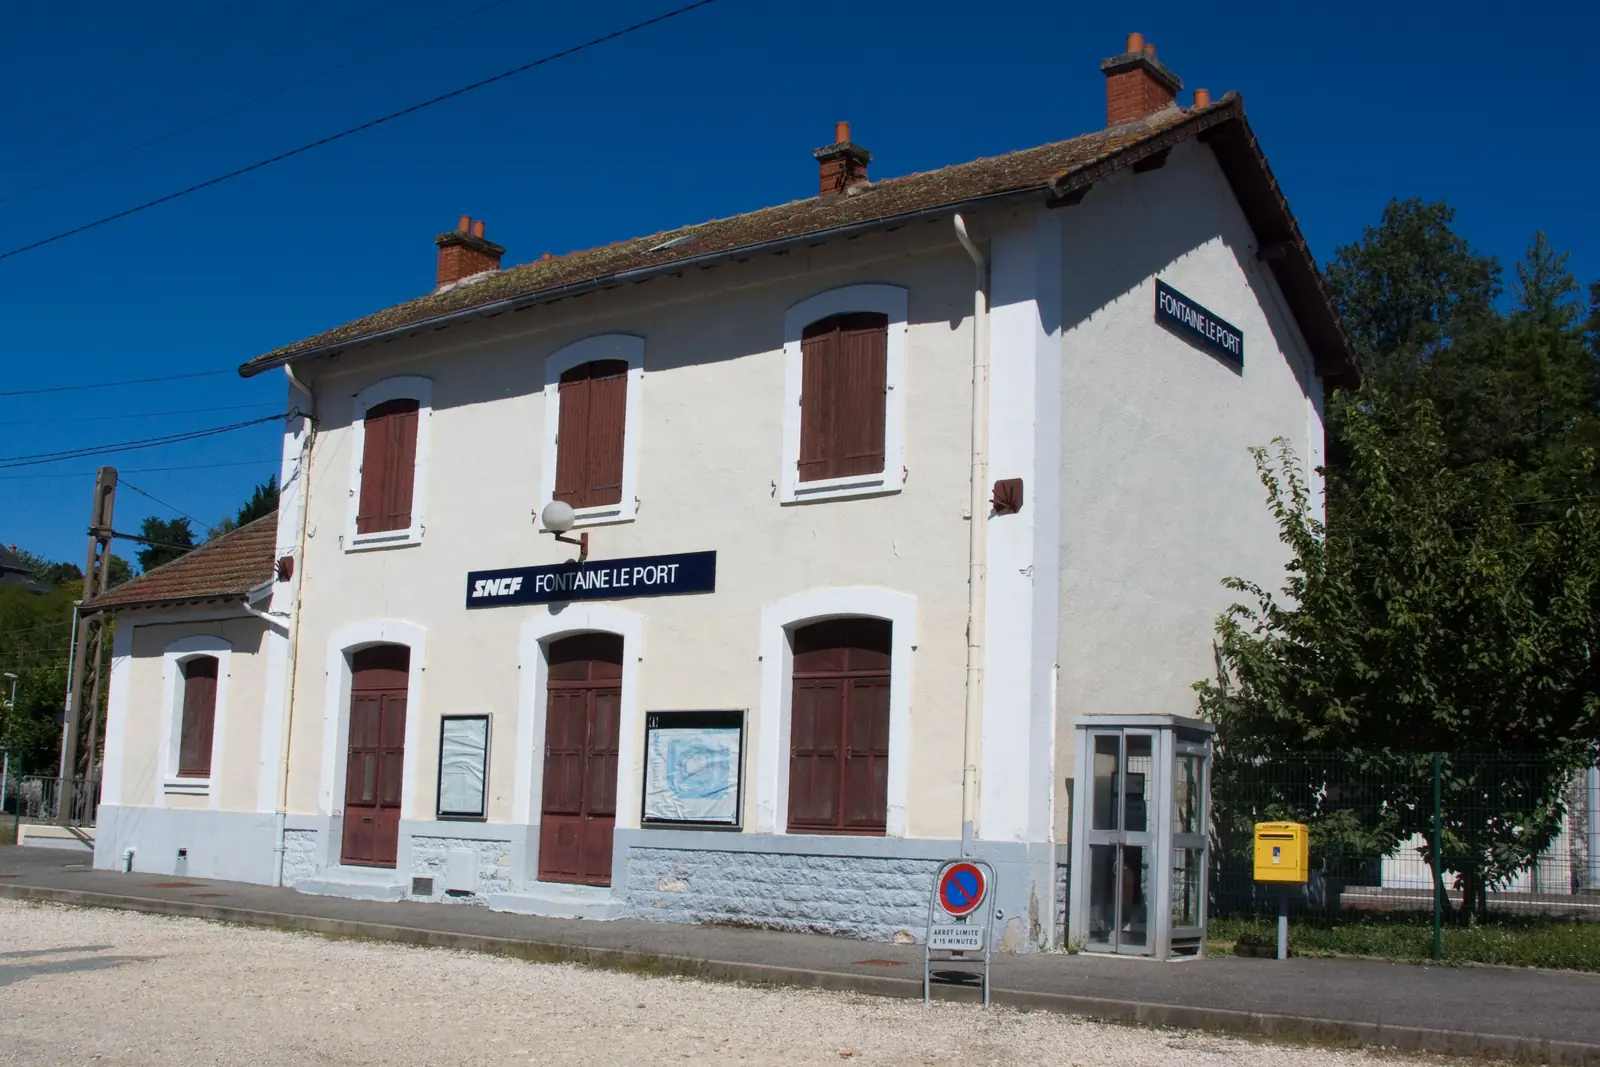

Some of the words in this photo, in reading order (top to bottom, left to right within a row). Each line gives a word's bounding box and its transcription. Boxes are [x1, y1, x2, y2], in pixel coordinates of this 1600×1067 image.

[1160, 291, 1205, 334] FONTAINE
[1206, 319, 1215, 340] LE
[1216, 325, 1240, 354] PORT
[472, 577, 523, 598] SNCF
[535, 570, 610, 593] FONTAINE
[612, 568, 630, 587] LE
[633, 564, 679, 585] PORT
